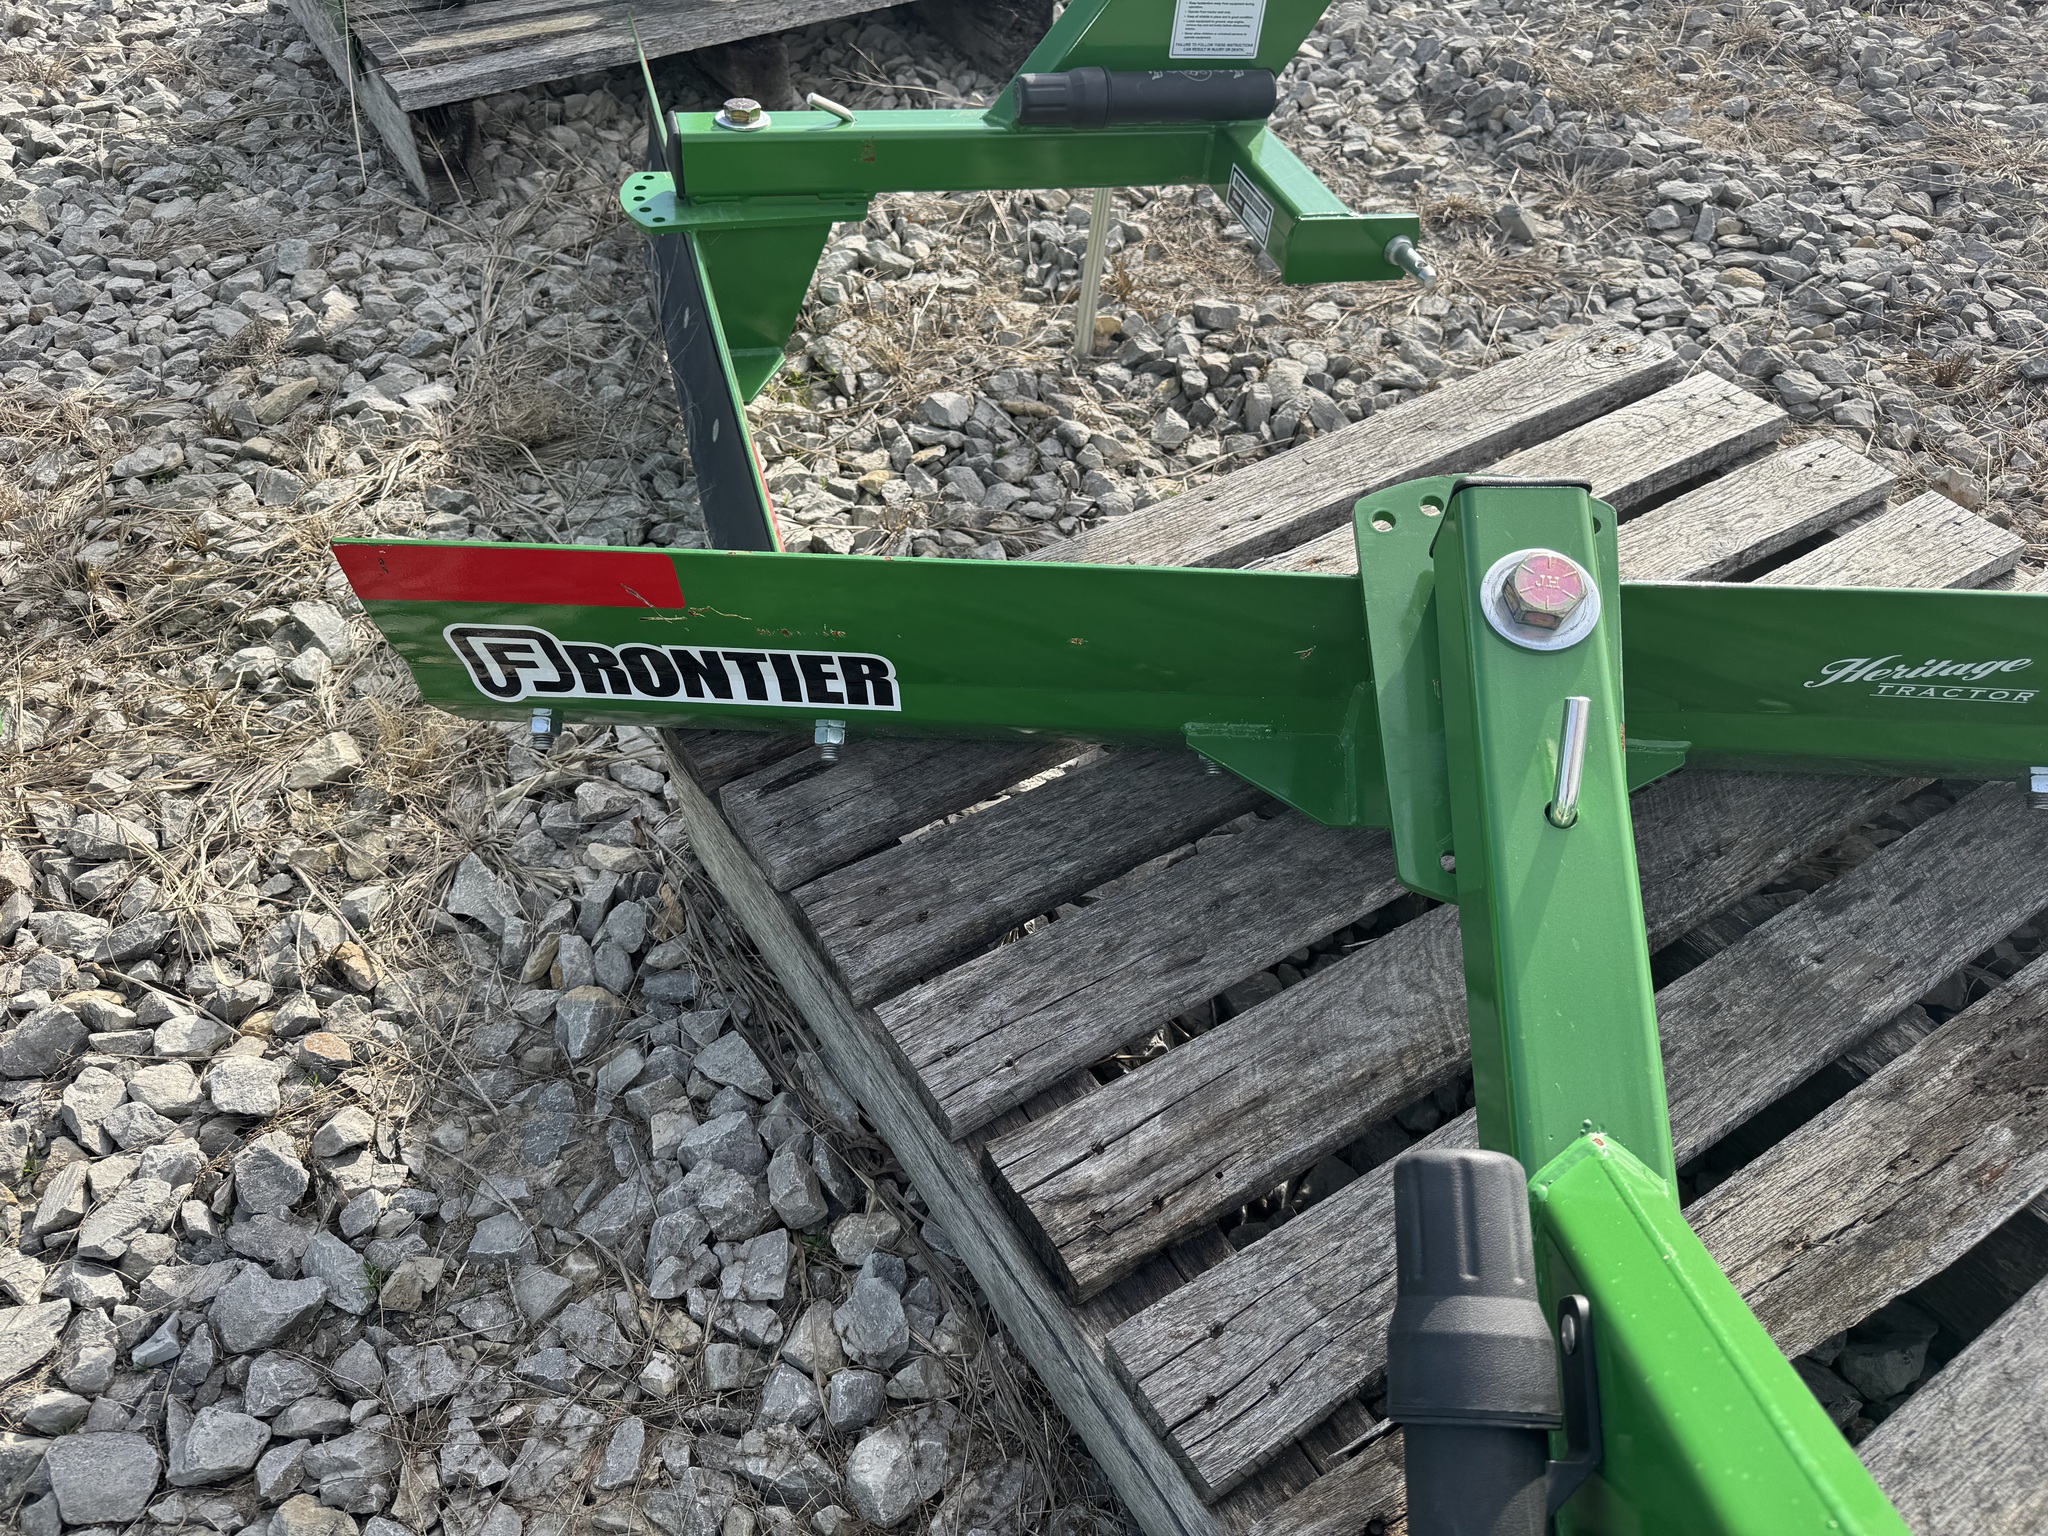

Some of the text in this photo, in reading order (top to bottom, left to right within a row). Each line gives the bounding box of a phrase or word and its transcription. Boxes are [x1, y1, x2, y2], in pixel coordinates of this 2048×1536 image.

[1535, 574, 1561, 589] JH
[446, 624, 896, 708] FRONTIER
[1803, 654, 2034, 688] Heritage
[1877, 684, 2035, 702] TRACTOR
